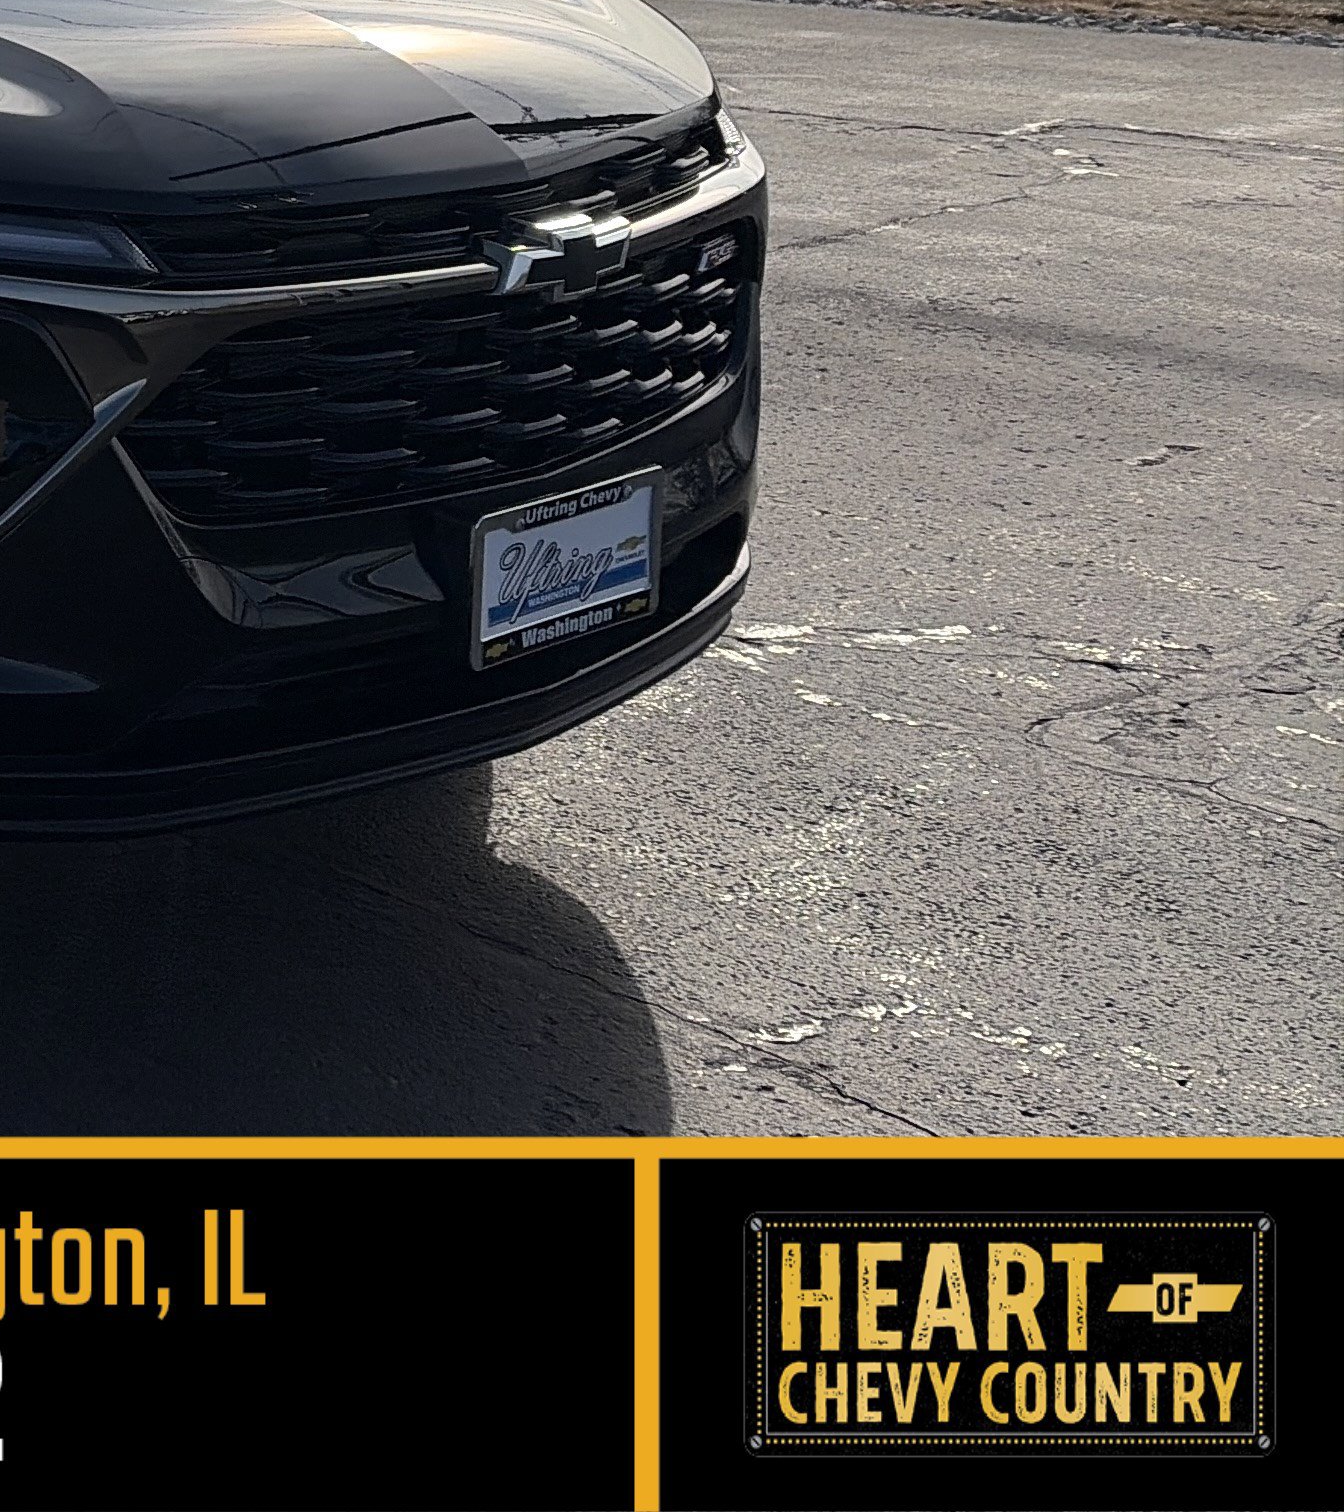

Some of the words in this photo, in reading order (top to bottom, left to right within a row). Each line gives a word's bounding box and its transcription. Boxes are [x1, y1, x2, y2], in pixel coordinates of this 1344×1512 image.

[525, 500, 577, 524] Uftring
[580, 485, 621, 508] Chevy
[498, 539, 614, 624] Uftring
[528, 585, 580, 607] WASHINGTON
[521, 607, 613, 648] Washington
